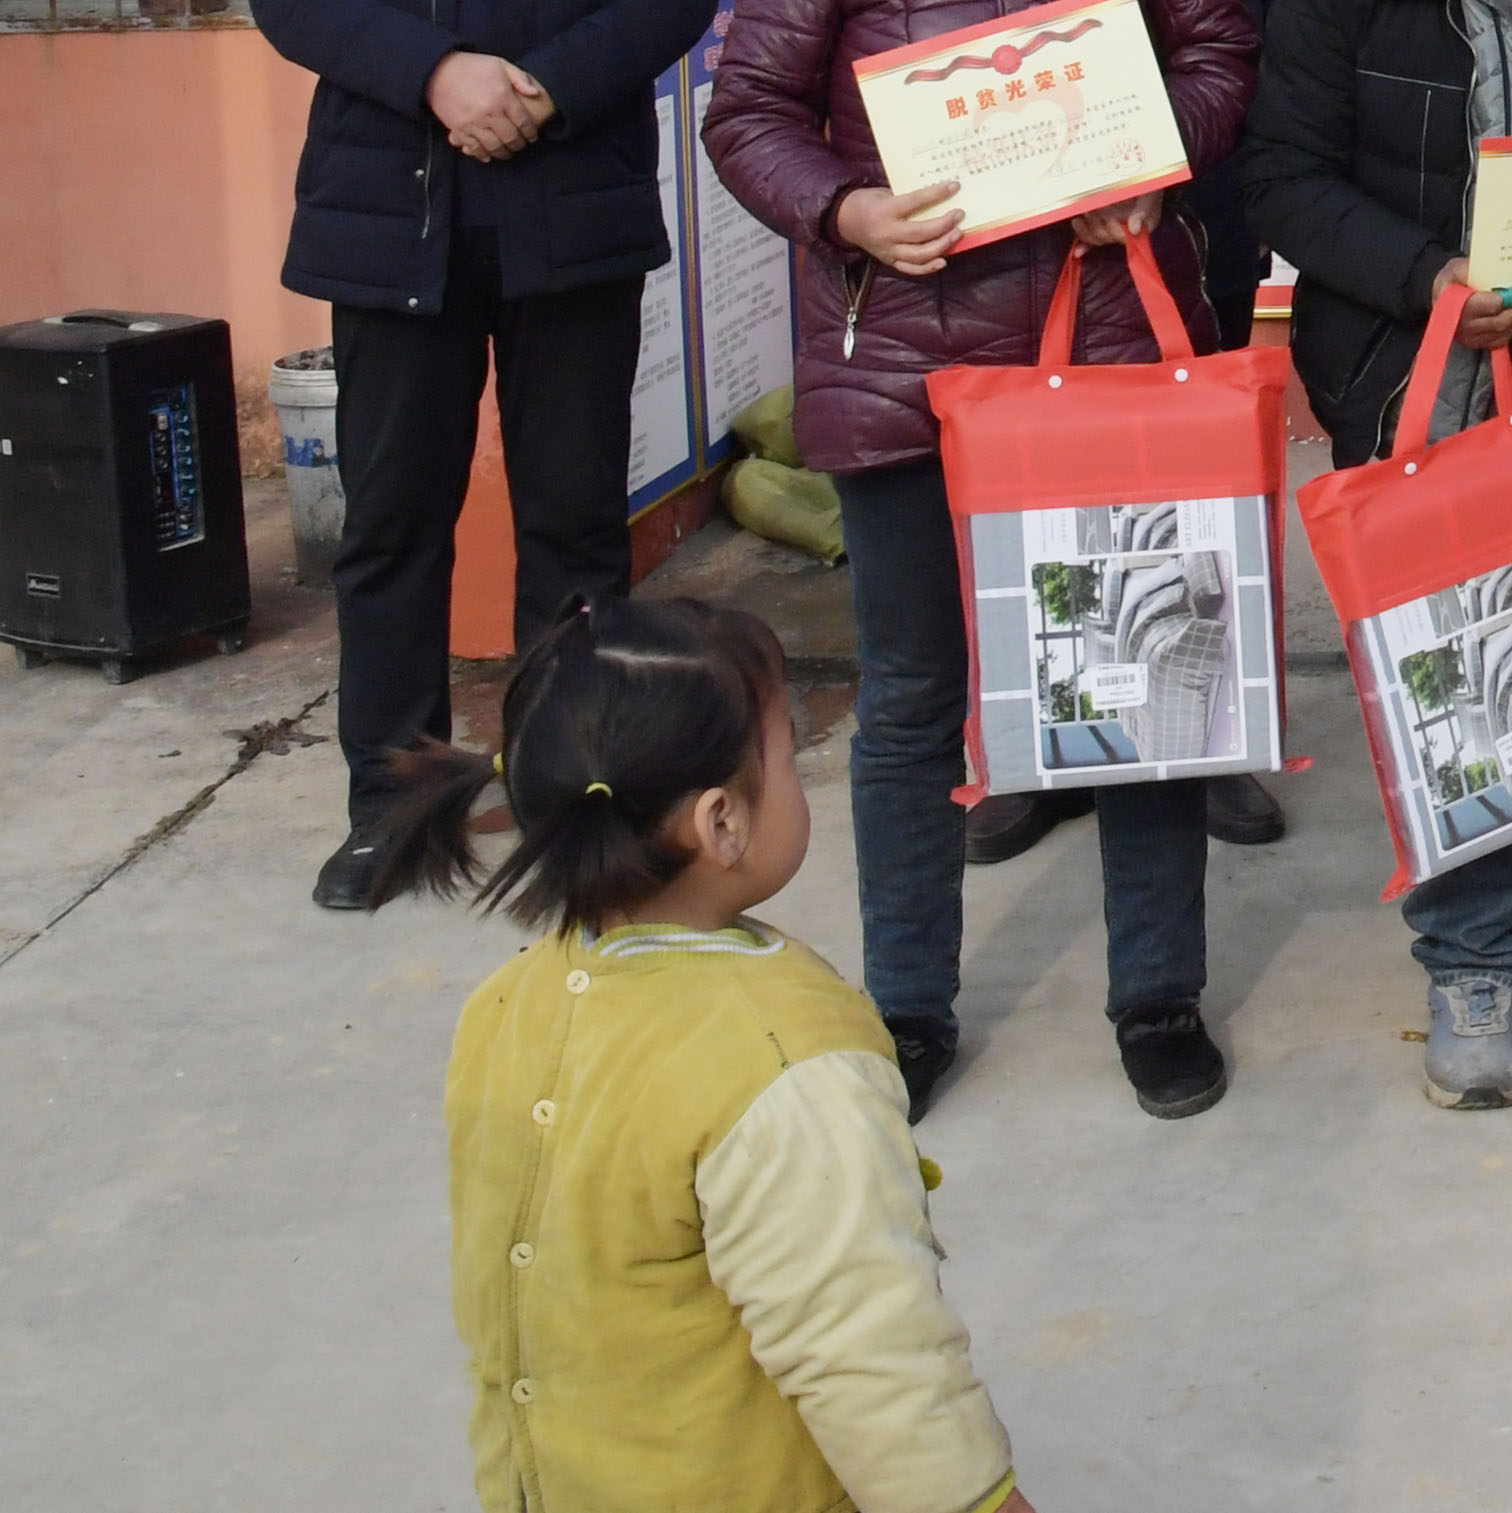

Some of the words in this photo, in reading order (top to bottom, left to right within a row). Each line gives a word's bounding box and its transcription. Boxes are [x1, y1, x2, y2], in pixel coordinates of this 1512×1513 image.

[944, 61, 1086, 120] 脱贫光荣证
